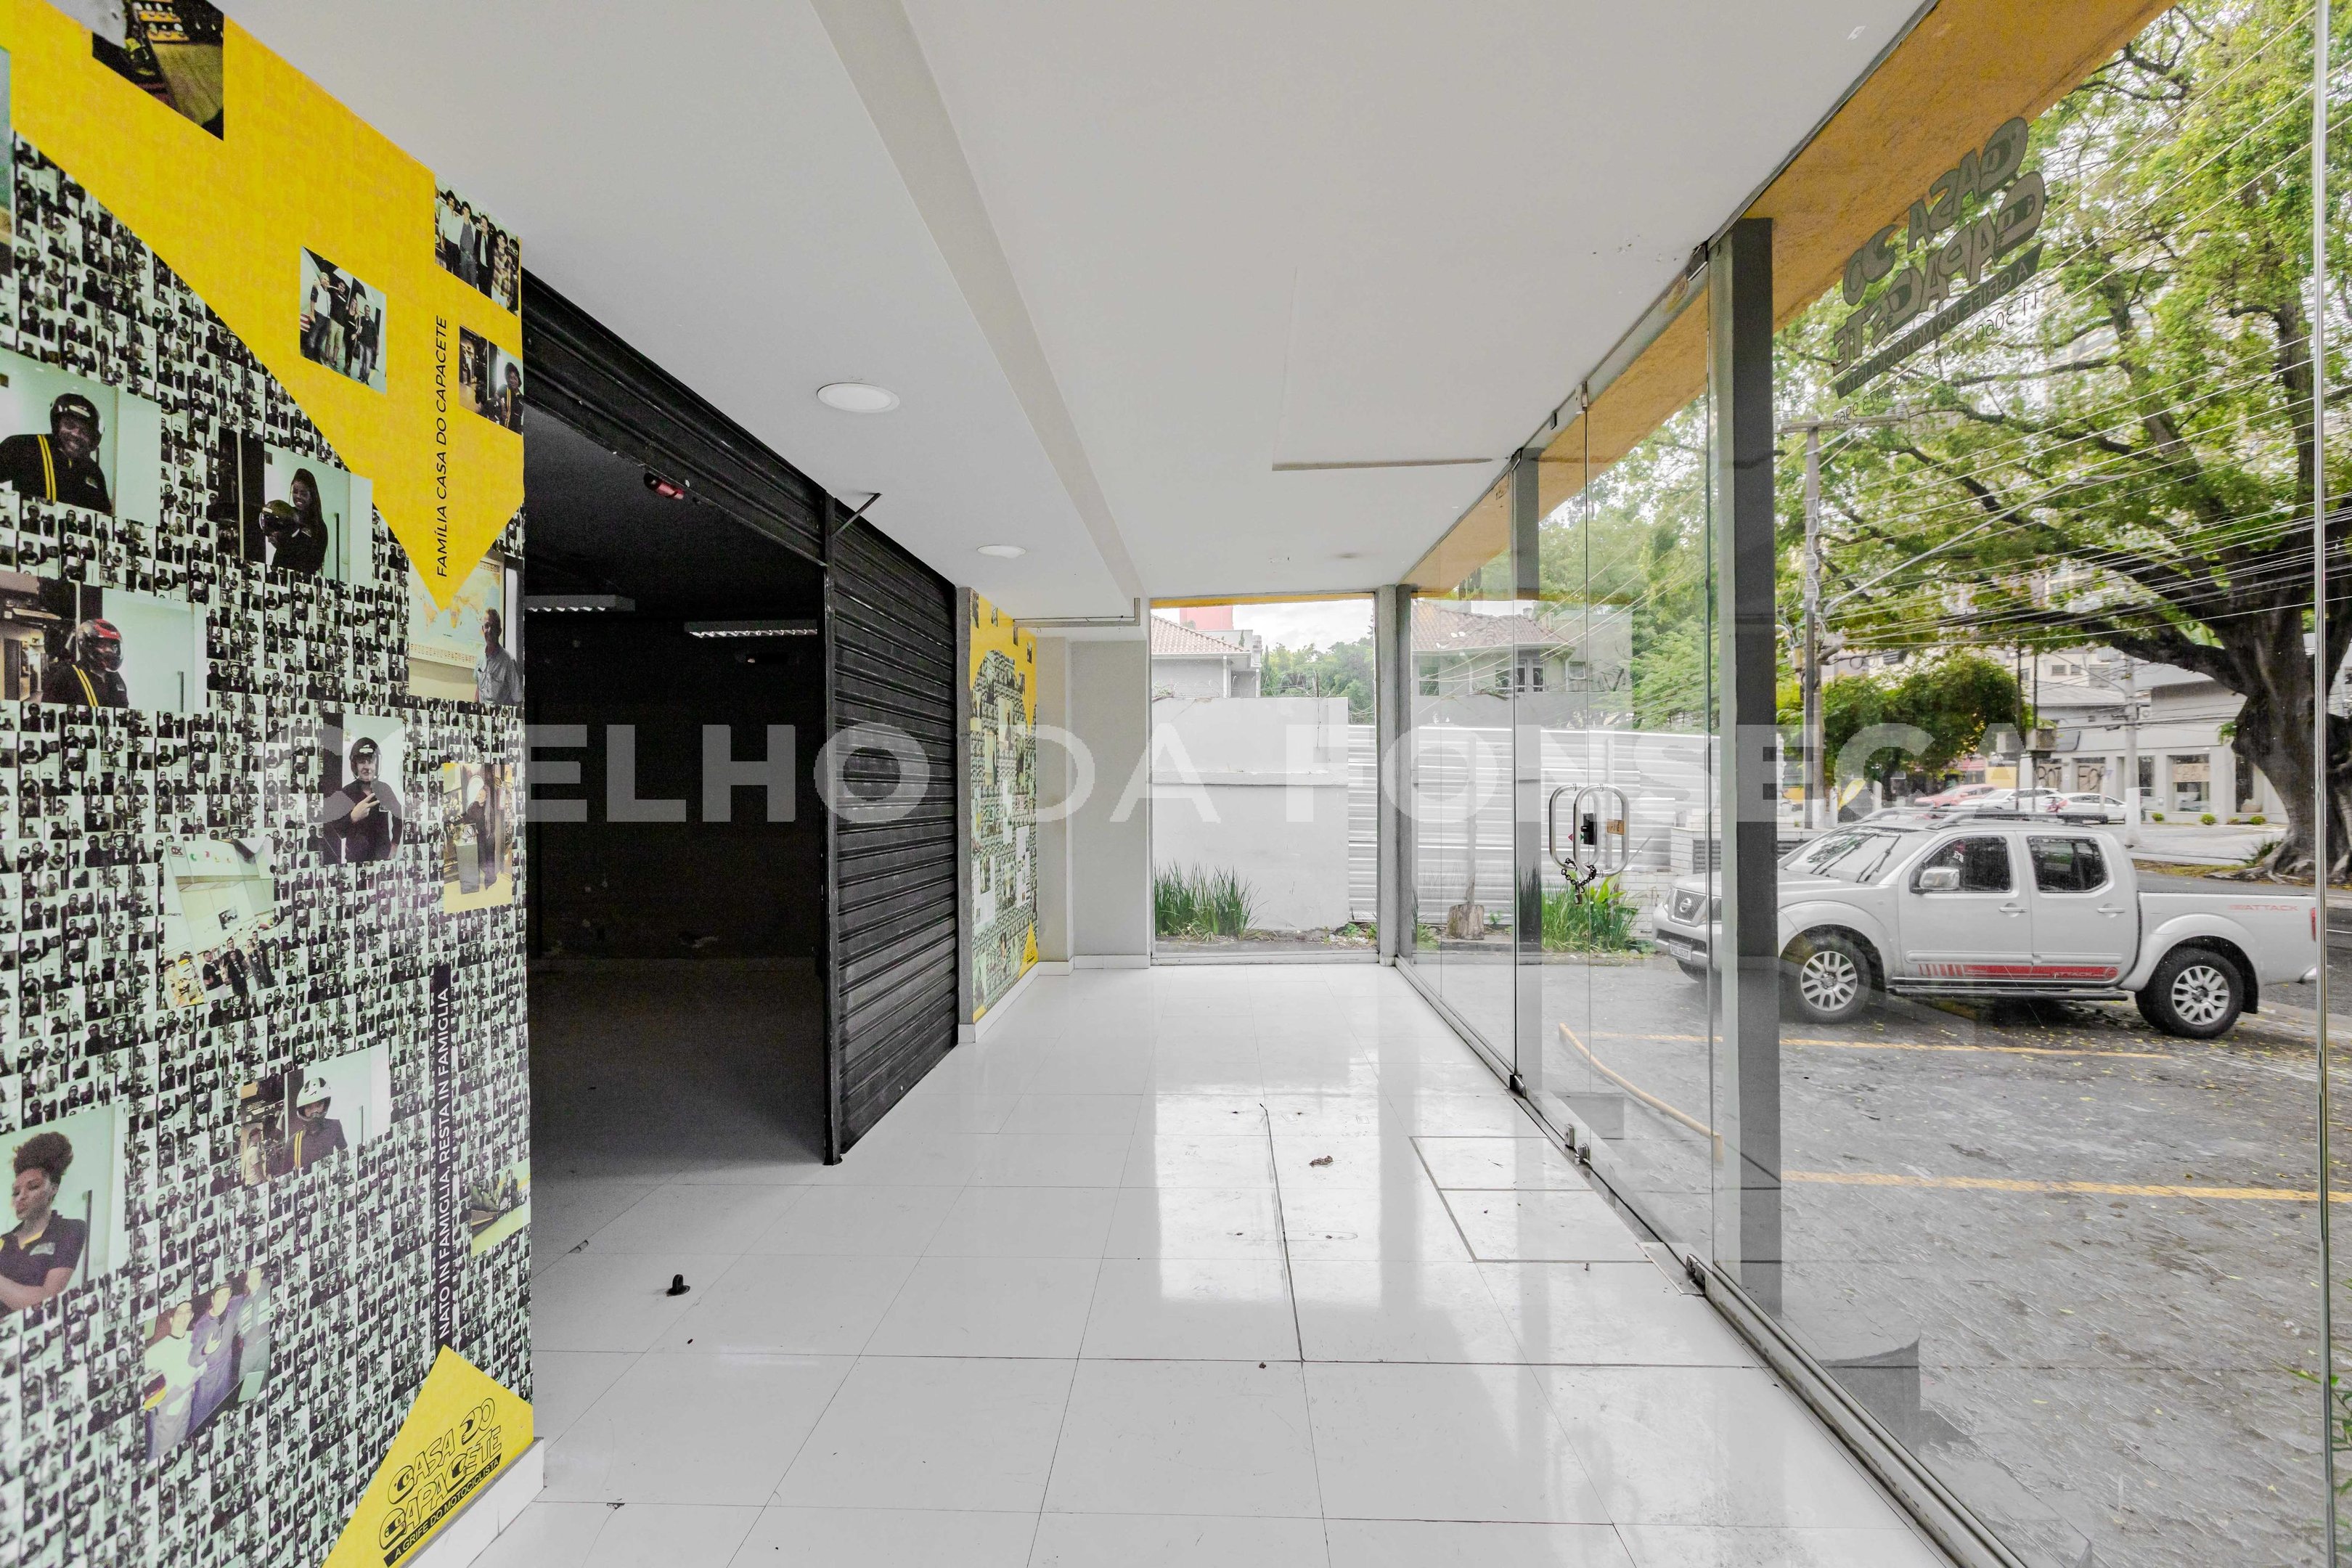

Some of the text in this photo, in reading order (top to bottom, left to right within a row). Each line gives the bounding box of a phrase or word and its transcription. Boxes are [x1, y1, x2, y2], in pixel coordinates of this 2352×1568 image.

[433, 315, 447, 577] FAMÍLIA CASA DO CAPACETE
[438, 987, 449, 1076] FAMIGLIA
[438, 1079, 449, 1101] IN
[438, 1102, 451, 1161] RESTA
[438, 1263, 451, 1285] IN
[438, 1286, 451, 1339] NATO
[379, 1425, 502, 1551] CAPACETE
[388, 1397, 496, 1505] CASA DO
[394, 1459, 499, 1559] A GRIFE DO MOTOCICLISTA
